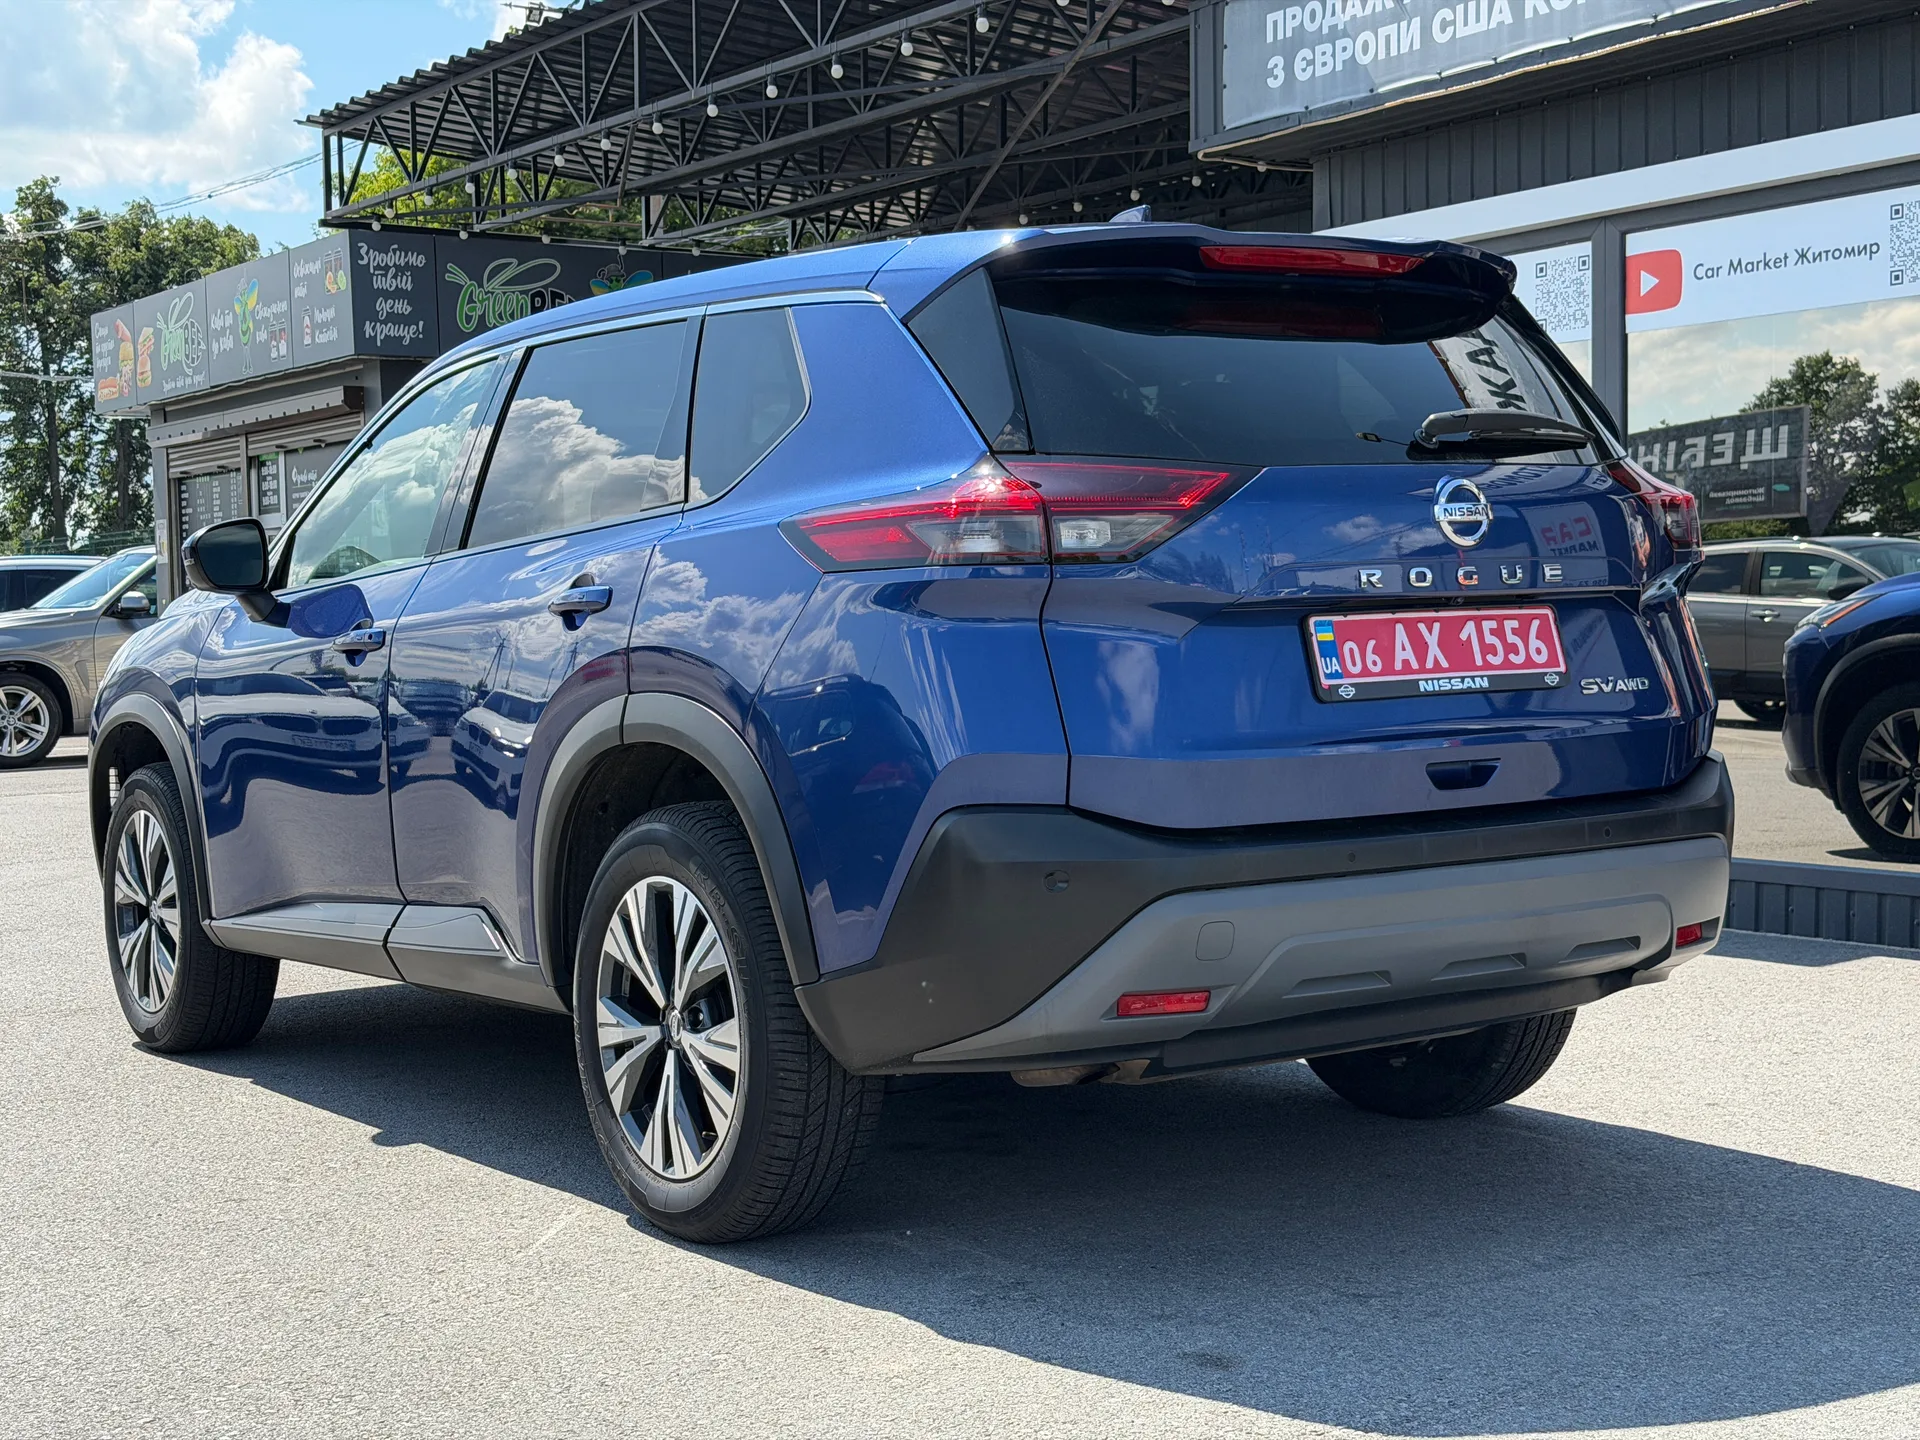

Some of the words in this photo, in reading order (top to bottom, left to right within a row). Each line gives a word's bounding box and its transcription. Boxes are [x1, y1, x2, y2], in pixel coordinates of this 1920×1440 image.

[1266, 55, 1285, 89] З
[1293, 16, 1421, 82] ЄВРОПИ
[1432, 0, 1514, 44] США
[357, 242, 427, 274] Зробимо
[1693, 262, 1722, 281] Car
[1727, 252, 1789, 276] Market
[1794, 241, 1881, 267] Житомир
[372, 267, 413, 291] твій
[375, 297, 412, 320] день
[363, 320, 424, 347] краще!
[1443, 506, 1488, 517] NISSAN
[1358, 563, 1564, 588] ROGUE
[1321, 657, 1342, 674] UA
[1342, 639, 1383, 675] 06
[1394, 621, 1450, 671] AX
[1459, 618, 1549, 667] 1556
[1419, 677, 1489, 693] NISSAN
[1580, 677, 1614, 695] SV
[1614, 677, 1649, 692] AWD
